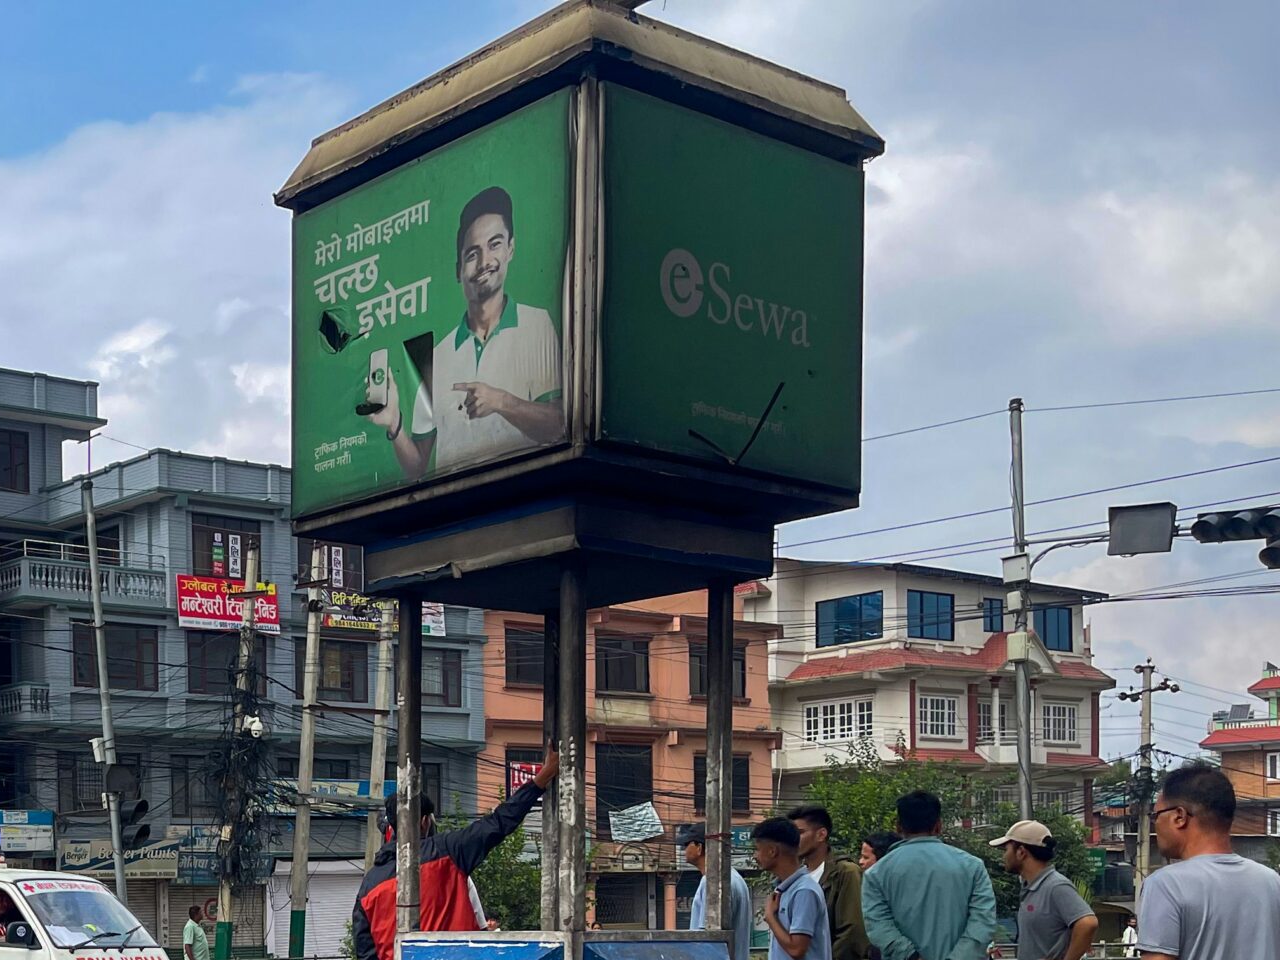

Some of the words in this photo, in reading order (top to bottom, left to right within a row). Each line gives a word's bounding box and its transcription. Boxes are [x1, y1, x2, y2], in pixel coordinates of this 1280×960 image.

[314, 234, 341, 267] मेरो
[346, 200, 431, 254] मोबाइलमा
[314, 254, 380, 305] चल्छ
[355, 277, 432, 339] इसेवा
[66, 851, 88, 862] Berger
[98, 847, 138, 860] Beer
[140, 847, 177, 860] Paints
